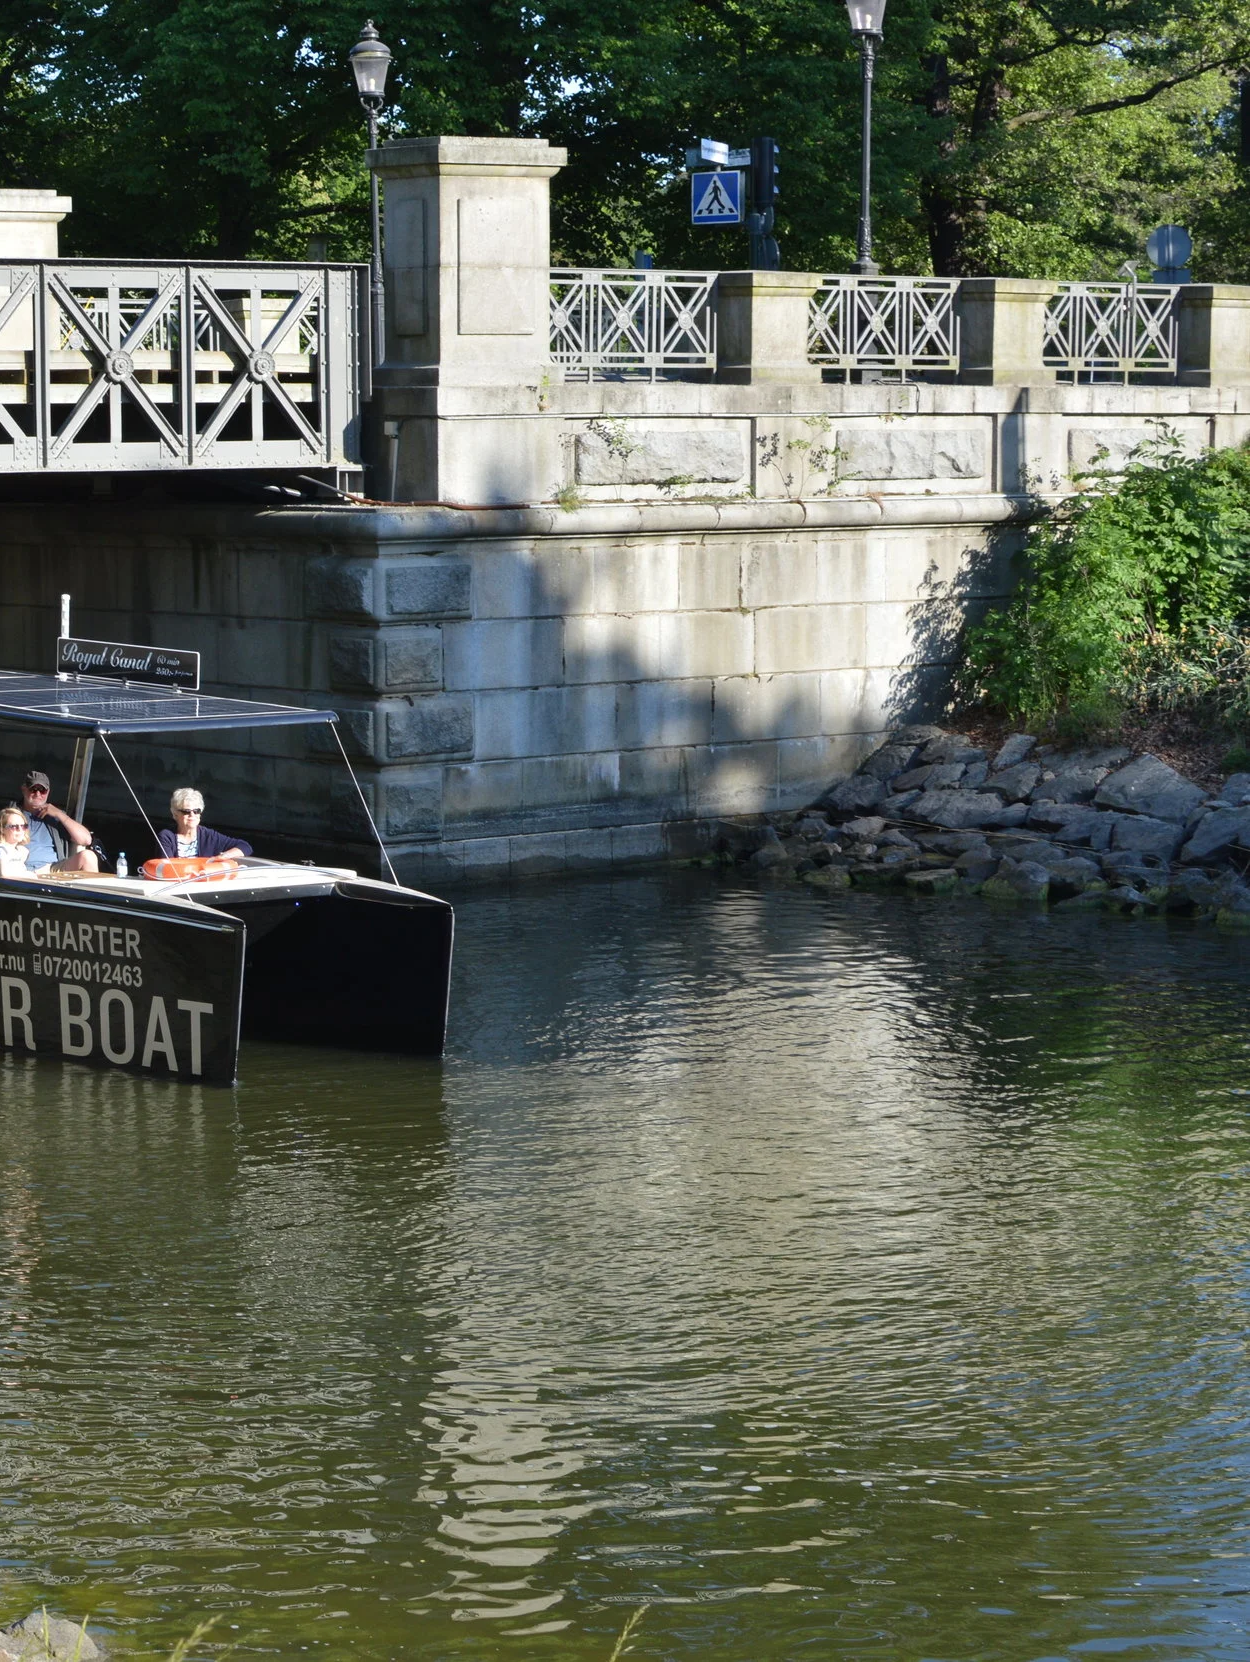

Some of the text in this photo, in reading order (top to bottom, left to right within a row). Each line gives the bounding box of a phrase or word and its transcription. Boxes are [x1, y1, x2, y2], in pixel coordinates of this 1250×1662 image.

[61, 642, 153, 672] Royal Canal
[30, 917, 143, 960] CHARTER
[43, 955, 143, 988] 0720012463
[59, 983, 214, 1076] BOAT
